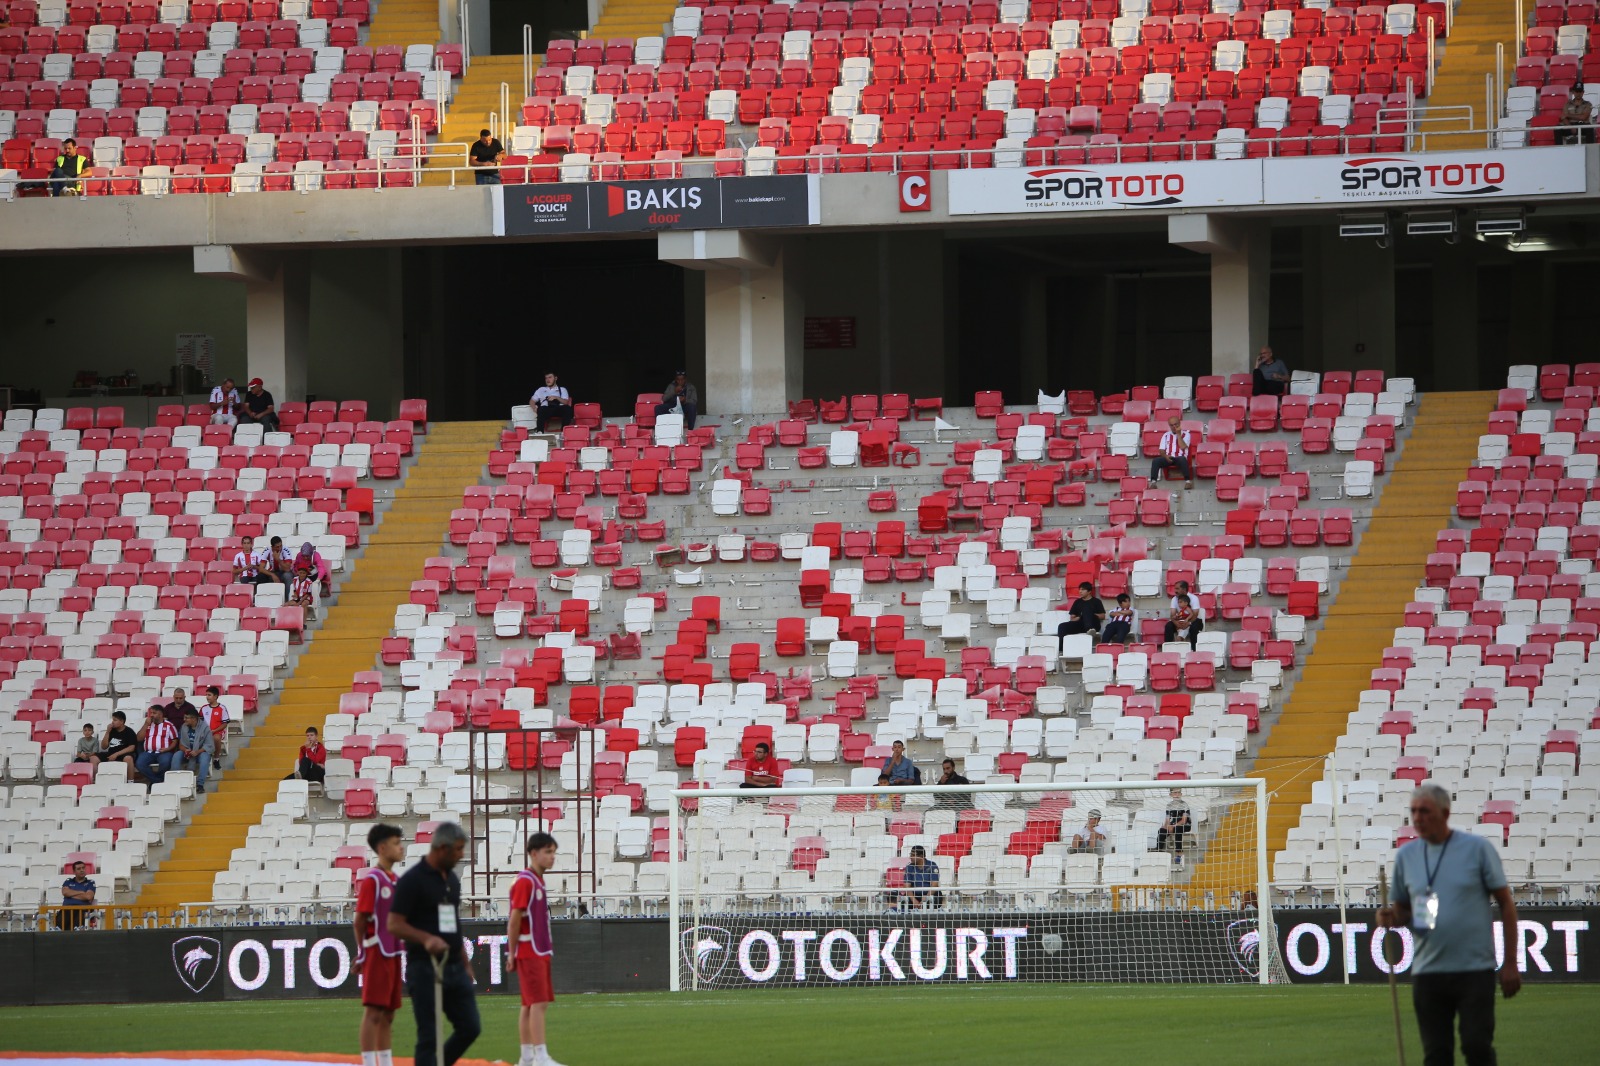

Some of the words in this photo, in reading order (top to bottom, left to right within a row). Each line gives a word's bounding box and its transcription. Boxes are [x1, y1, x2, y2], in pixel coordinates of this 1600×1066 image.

[527, 194, 573, 204] LACQUER
[626, 187, 702, 210] BAKIŞ
[902, 175, 927, 207] C
[532, 204, 567, 212] TOUCH
[648, 212, 681, 224] door
[738, 928, 1028, 982] OTOKURT
